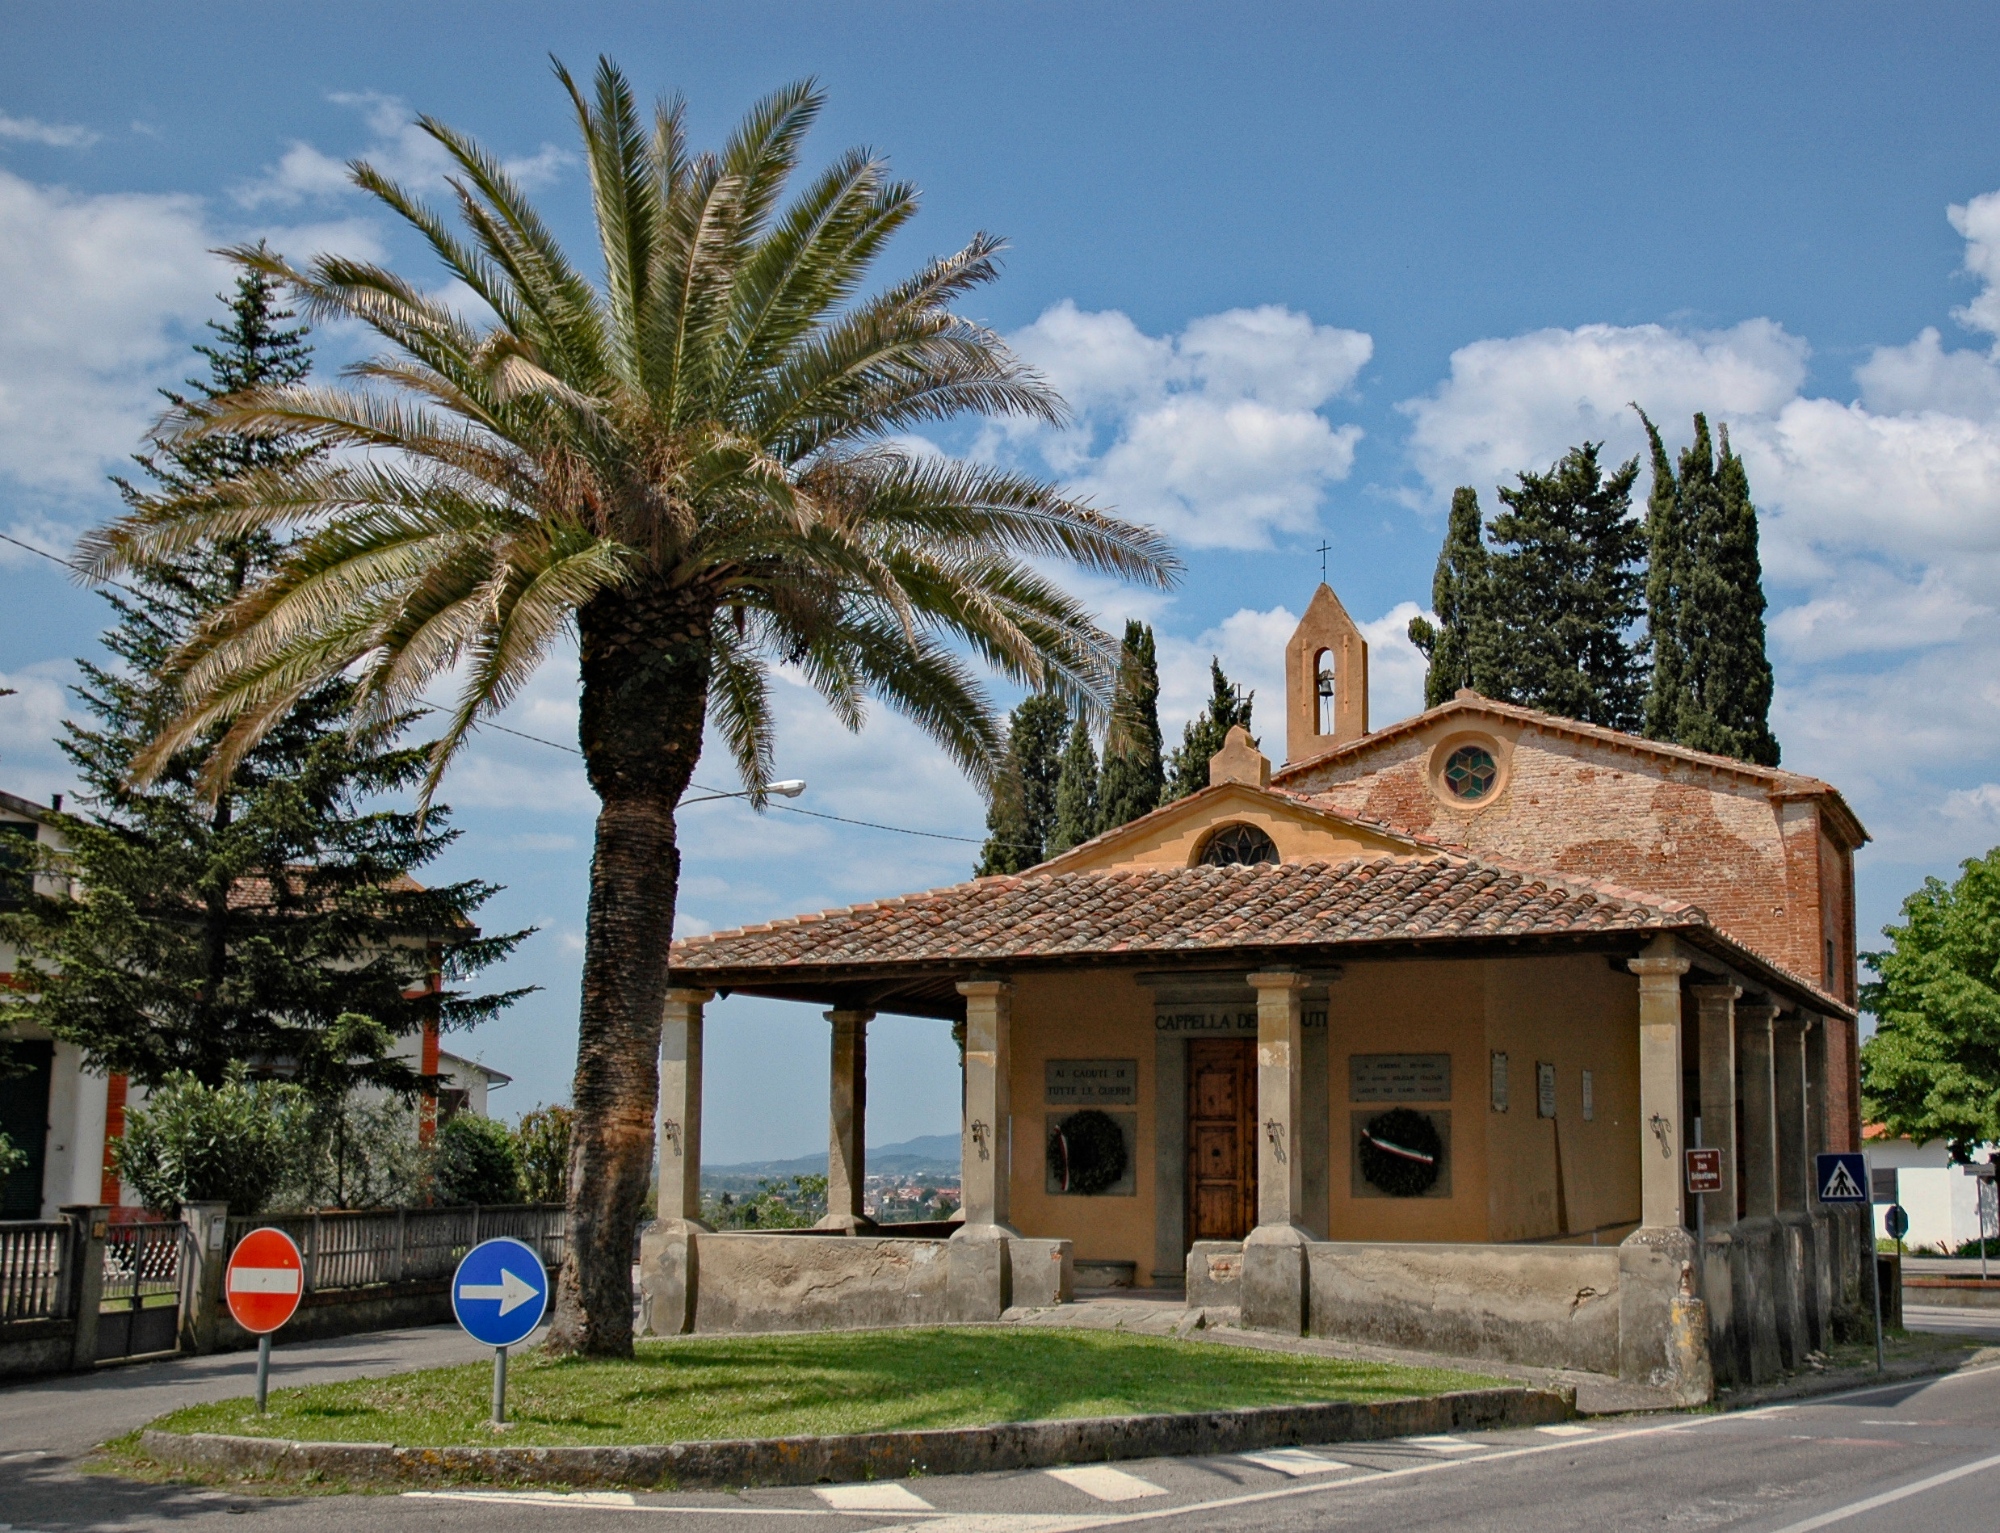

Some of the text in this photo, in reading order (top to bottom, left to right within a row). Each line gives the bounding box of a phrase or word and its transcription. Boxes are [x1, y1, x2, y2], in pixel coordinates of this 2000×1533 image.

[1155, 1011, 1328, 1030] CAPPELLA DE UTI
[1073, 1069, 1108, 1078] CADUTI
[1048, 1086, 1077, 1095] TUTTE
[1098, 1086, 1132, 1095] GUERRE
